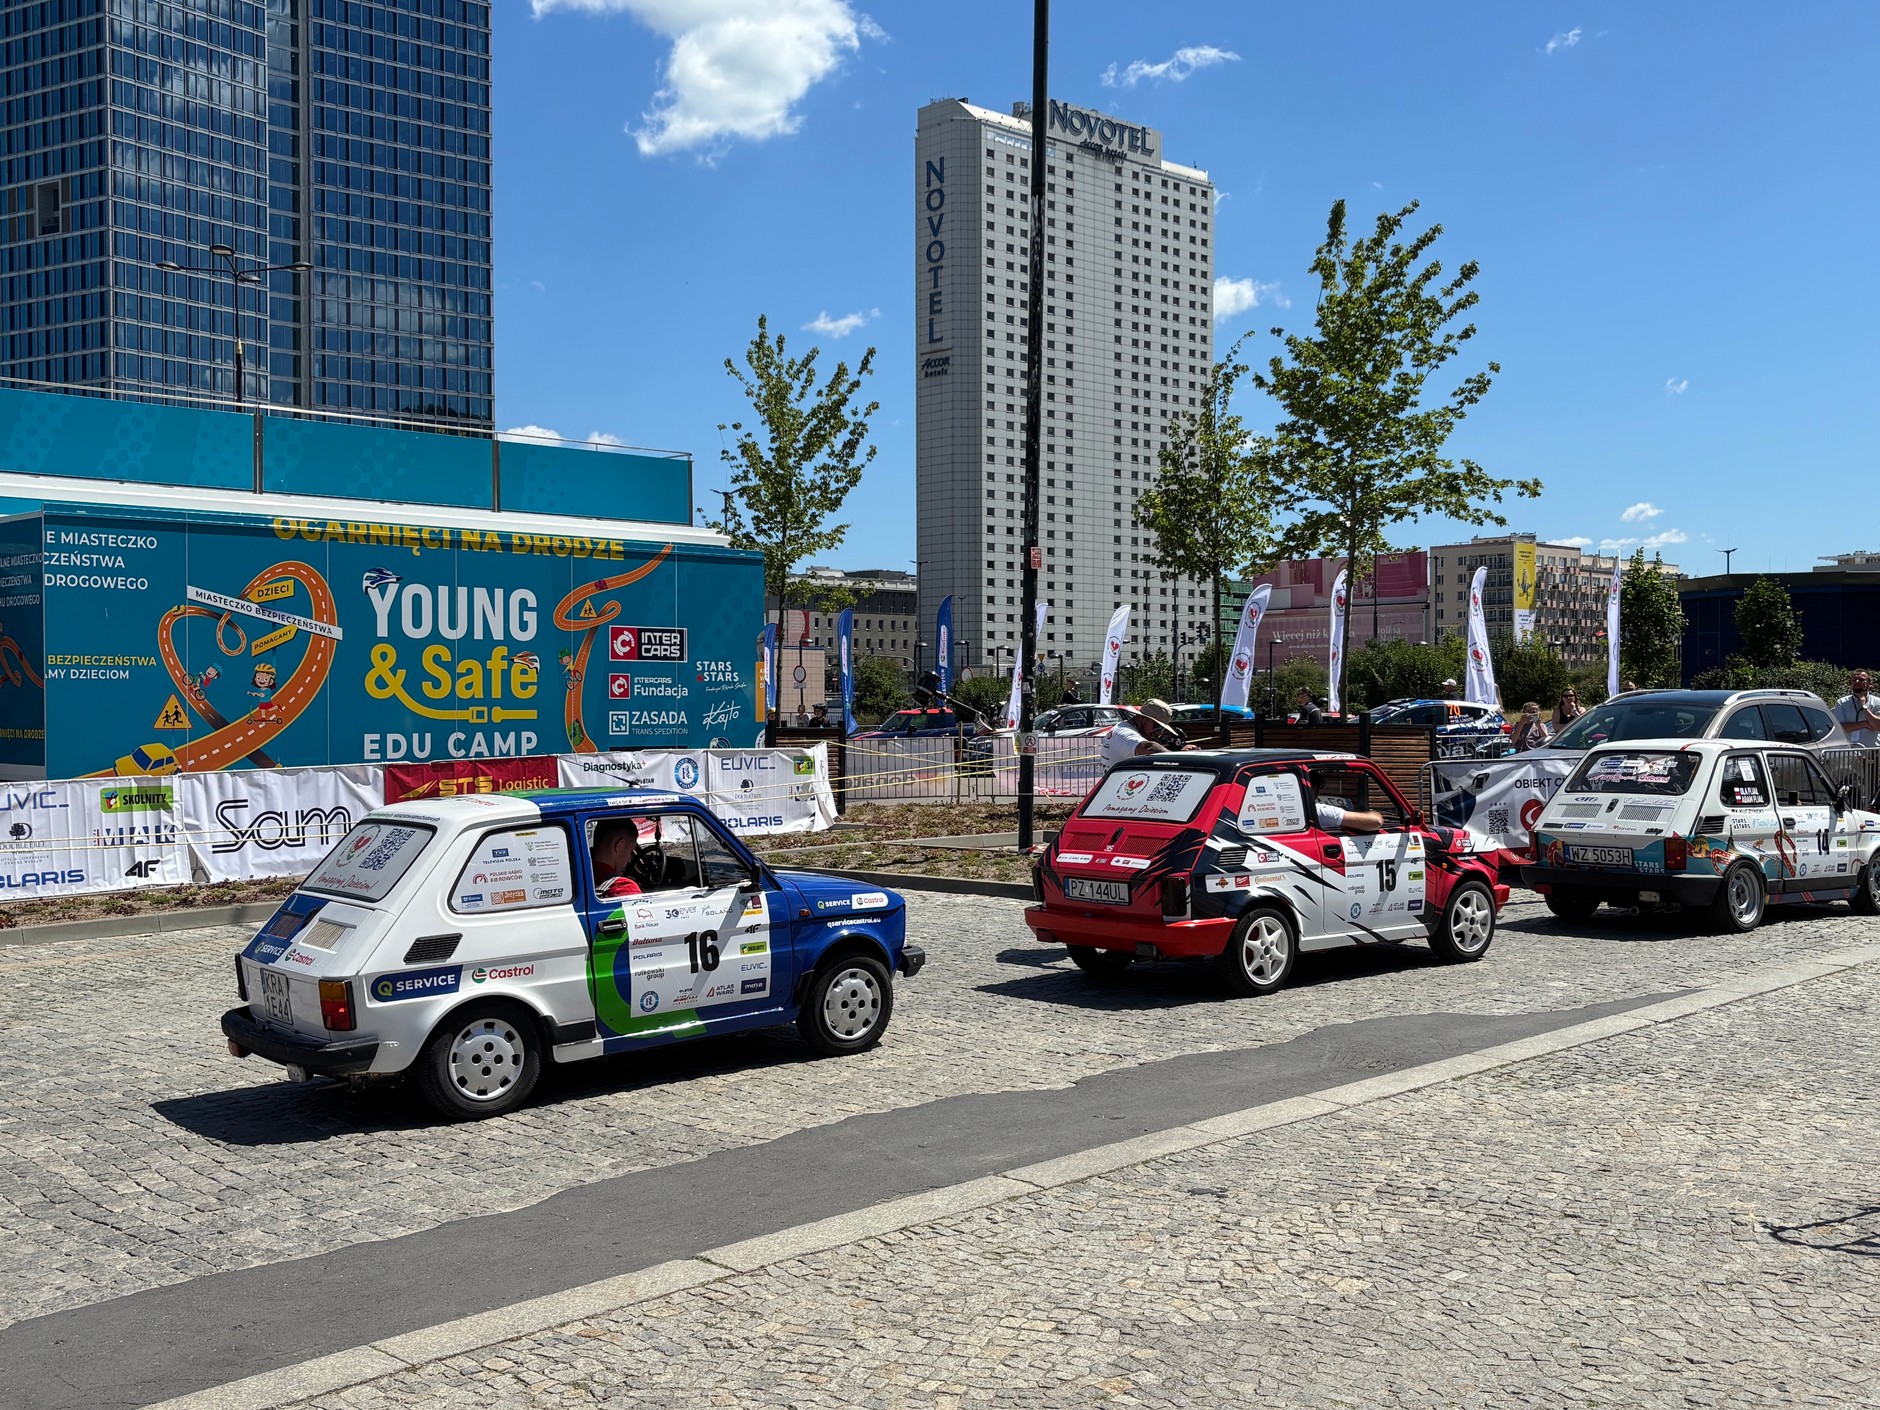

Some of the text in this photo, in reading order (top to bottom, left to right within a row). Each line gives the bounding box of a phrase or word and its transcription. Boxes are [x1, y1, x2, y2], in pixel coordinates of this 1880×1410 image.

[1049, 99, 1155, 156] NOVOTEL
[926, 157, 945, 344] NOVOTEL
[60, 532, 157, 549] MIASTECZKO
[273, 516, 625, 561] OGARNIĘCI NA DRODZE
[44, 574, 149, 590] DROGOWEGO
[257, 584, 290, 598] DZIECI
[195, 590, 333, 635] MIASTECZKO BEZPIECZEŃSTWA
[368, 583, 538, 641] YOUNG
[641, 632, 681, 645] INTER
[641, 646, 681, 657] CARS
[48, 653, 157, 667] BEZPIECZEŃSTWA
[696, 661, 732, 671] STARS
[70, 669, 129, 680] DZIECIOM
[364, 643, 538, 699] & Safe
[634, 685, 689, 699] Fundacja
[631, 711, 688, 725] ZASADA
[363, 731, 538, 760] EDU CAMP
[439, 776, 549, 796] STS Logistic
[1514, 778, 1552, 789] OBIEKT
[123, 793, 166, 806] SKOLNITY
[1103, 804, 1138, 814] Pomagamy
[1571, 847, 1630, 865] WZ 5053H
[125, 859, 161, 878] 4F
[1376, 859, 1397, 893] 15
[1071, 880, 1126, 901] PZ 144UL
[825, 899, 851, 907] SERVICE
[262, 943, 285, 957] SERVICE
[633, 952, 663, 960] POLARIS
[684, 929, 720, 974] 16
[292, 953, 315, 966] Castrol
[488, 964, 534, 980] Castrol
[635, 968, 665, 977] rutkowski
[647, 973, 664, 982] group
[264, 971, 284, 997] KRA
[396, 974, 456, 992] SERVICE
[716, 989, 734, 997] WARD
